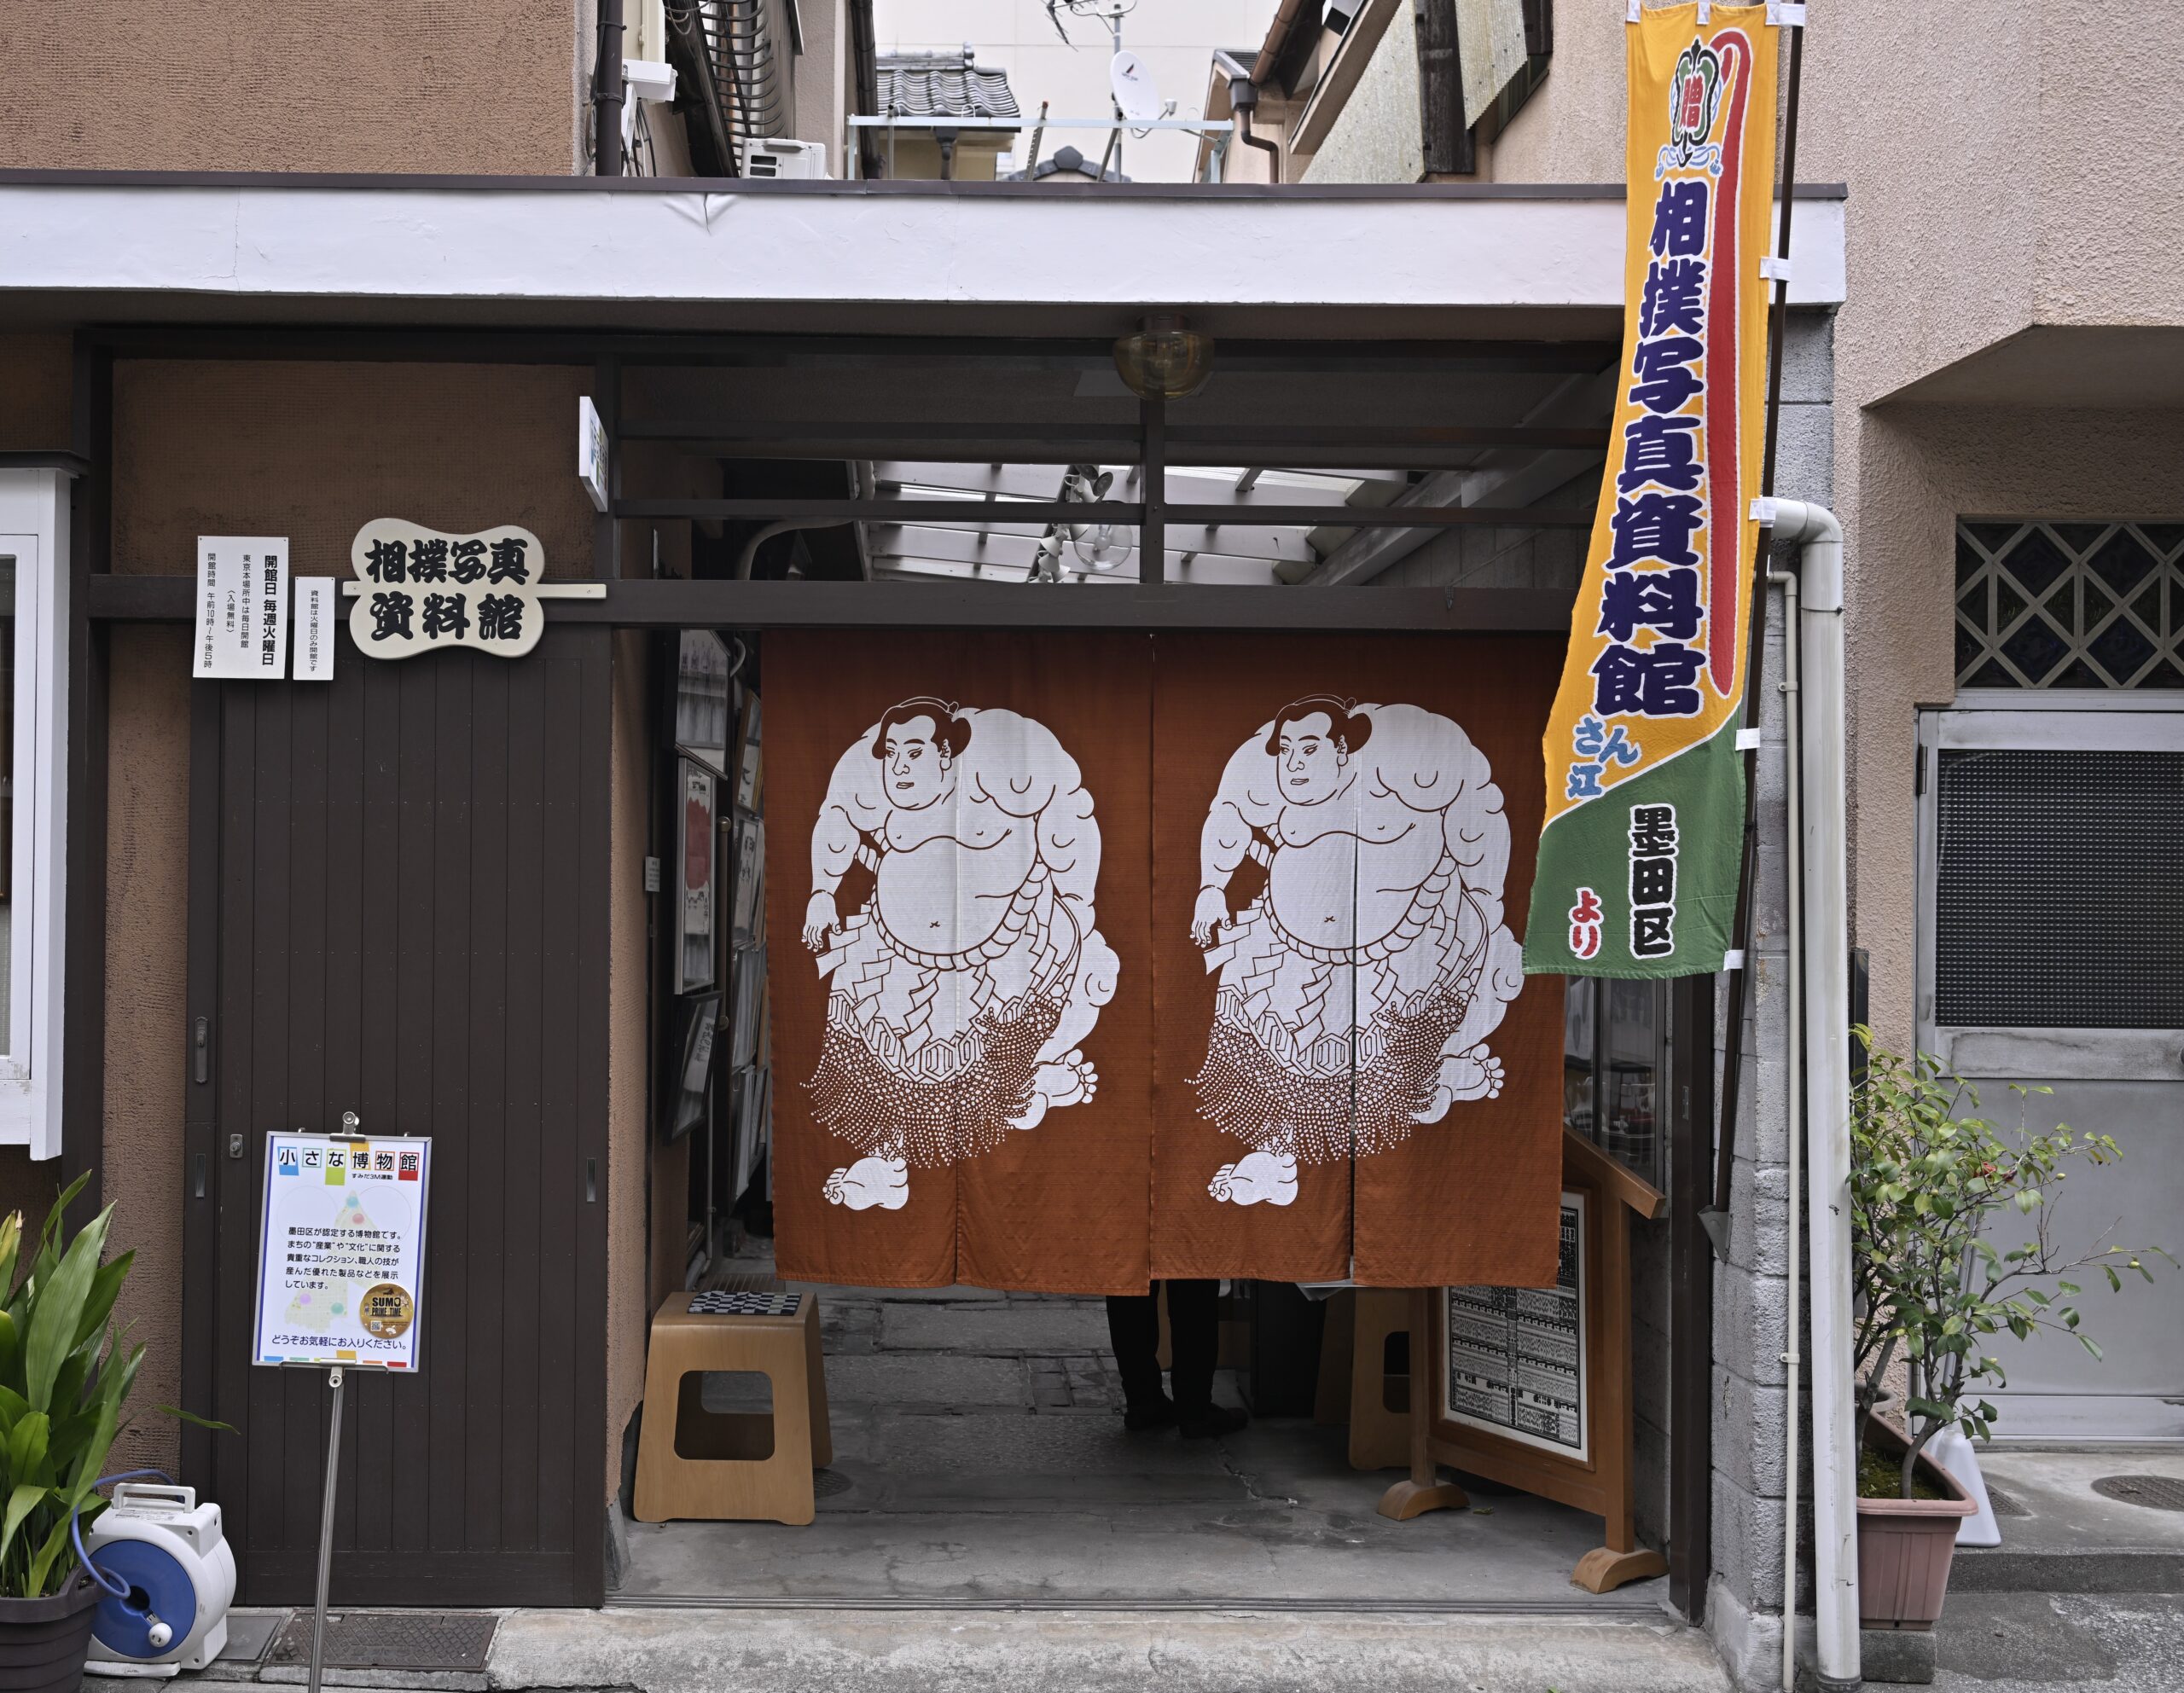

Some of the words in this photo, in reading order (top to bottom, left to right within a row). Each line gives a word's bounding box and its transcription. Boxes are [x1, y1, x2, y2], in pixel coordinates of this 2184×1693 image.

[1681, 72, 1705, 130] 贈
[1592, 179, 1708, 718] 相撲写真資料館
[206, 553, 217, 588] 開館時間
[264, 555, 278, 595] 開館日
[363, 537, 531, 585] 相撲写真
[240, 554, 251, 649] 東京本場所中は毎日開館
[369, 590, 524, 642] 資料館
[262, 599, 277, 666] 毎週火曜日
[309, 589, 319, 672] 資料館は火曜日のみ開館です
[1628, 803, 1679, 960] 墨田区
[1569, 887, 1602, 960] より
[279, 1149, 418, 1172] 小さな博物館
[288, 1226, 401, 1240] 墨田区が認定する博物館です。
[286, 1267, 398, 1279] 産んだ優れた製品などを展示
[287, 1254, 399, 1266] 貴重なコレクション、職人の技が
[285, 1279, 328, 1290] しています。
[372, 1297, 402, 1307] SUMO
[371, 1307, 387, 1317] PRIME
[389, 1307, 402, 1317] TIME
[271, 1334, 407, 1350] どうぞお気軽にお入りください。
